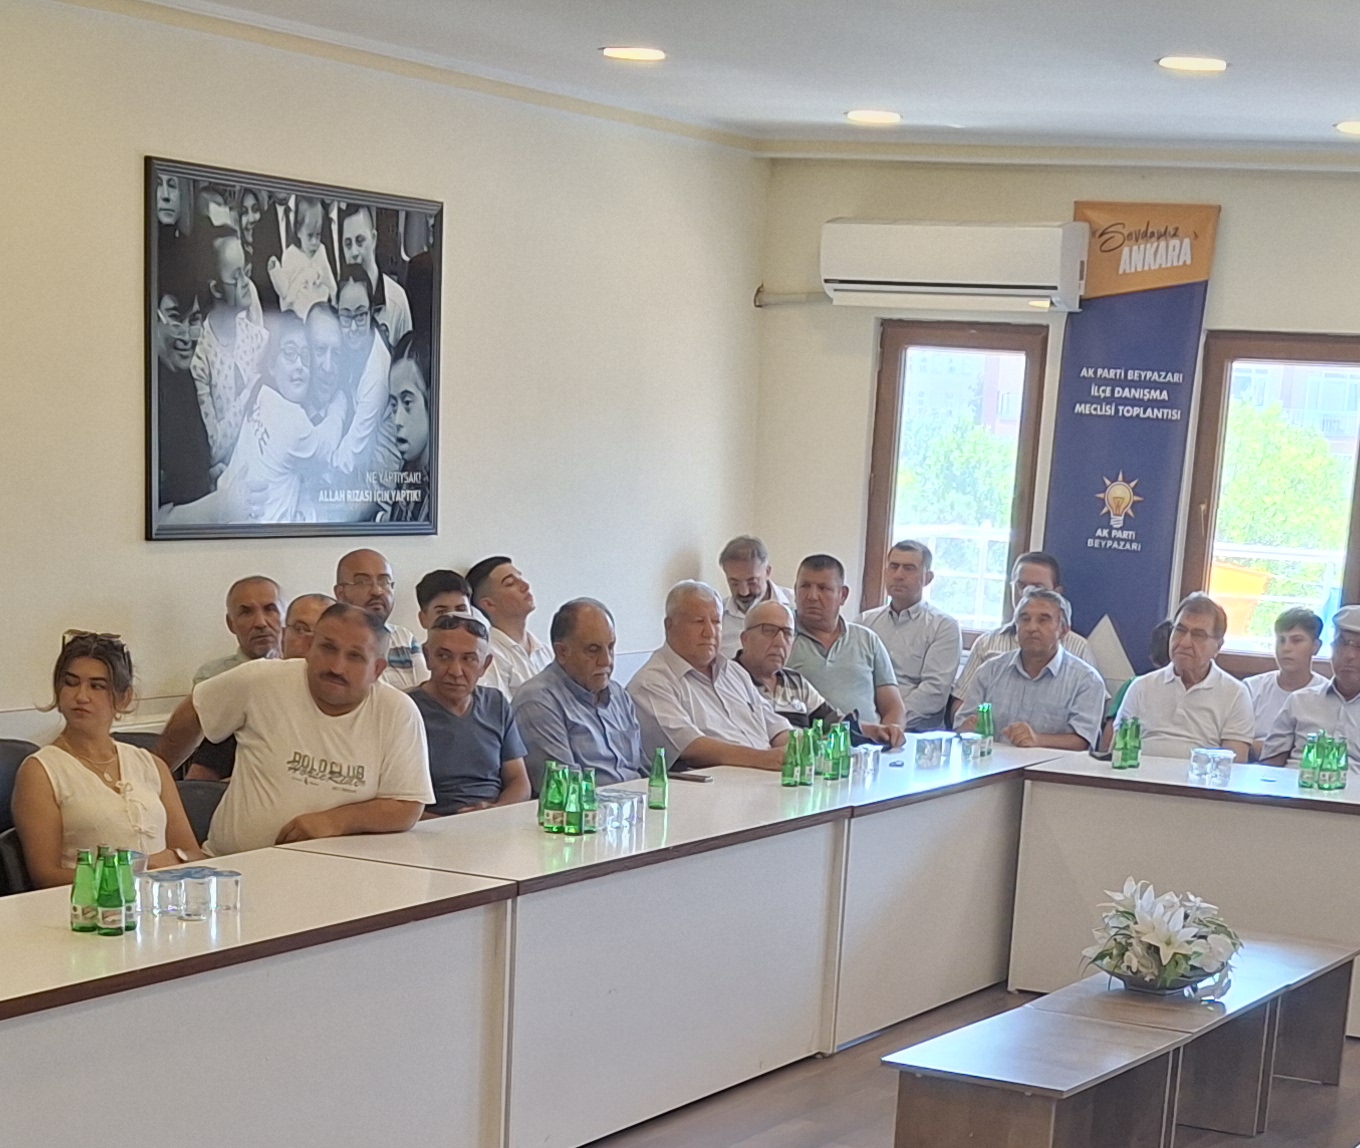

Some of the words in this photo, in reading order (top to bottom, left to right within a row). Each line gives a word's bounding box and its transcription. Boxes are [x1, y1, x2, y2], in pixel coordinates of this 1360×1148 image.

[1118, 237, 1192, 275] ANKARA
[1080, 366, 1095, 378] AK
[1096, 367, 1125, 380] PARTİ
[1127, 369, 1183, 383] BEYPAZARI
[1090, 383, 1112, 399] İLÇE
[1114, 386, 1169, 401] DANIŞMA
[1074, 402, 1115, 416] MECLİSİ
[1117, 405, 1181, 420] TOPLANTISI
[319, 489, 345, 502] ALLAH
[346, 489, 372, 502] RIZASI
[390, 489, 422, 502] YAPTIK!
[1095, 528, 1109, 538] AK
[1087, 538, 1142, 551] BEYPAZARI
